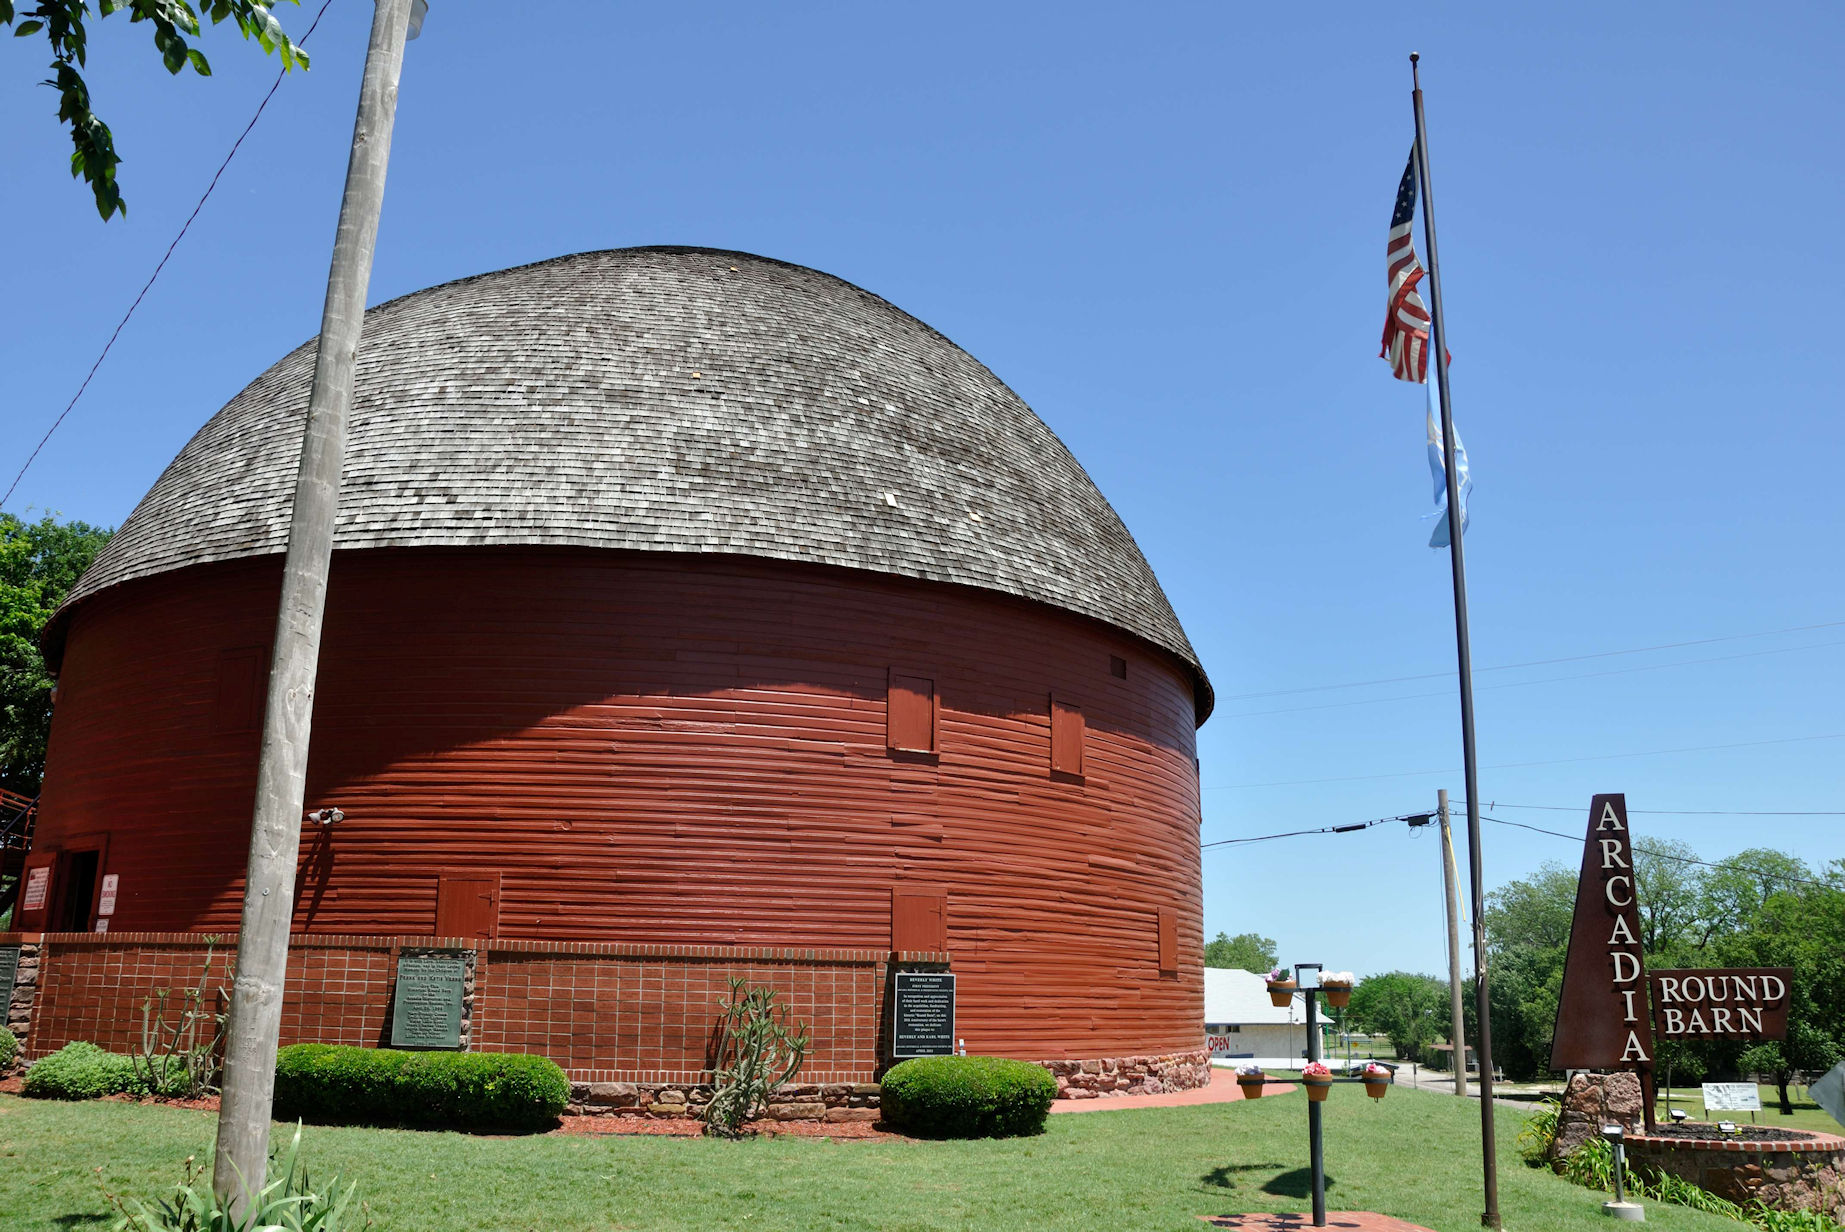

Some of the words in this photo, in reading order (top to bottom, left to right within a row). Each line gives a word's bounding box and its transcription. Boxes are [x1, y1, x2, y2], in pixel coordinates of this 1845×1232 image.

[1596, 802, 1650, 1061] ARCADIA
[1658, 976, 1785, 1003] ROUND
[1663, 1008, 1763, 1034] BARN
[1208, 1036, 1229, 1051] OPEN
